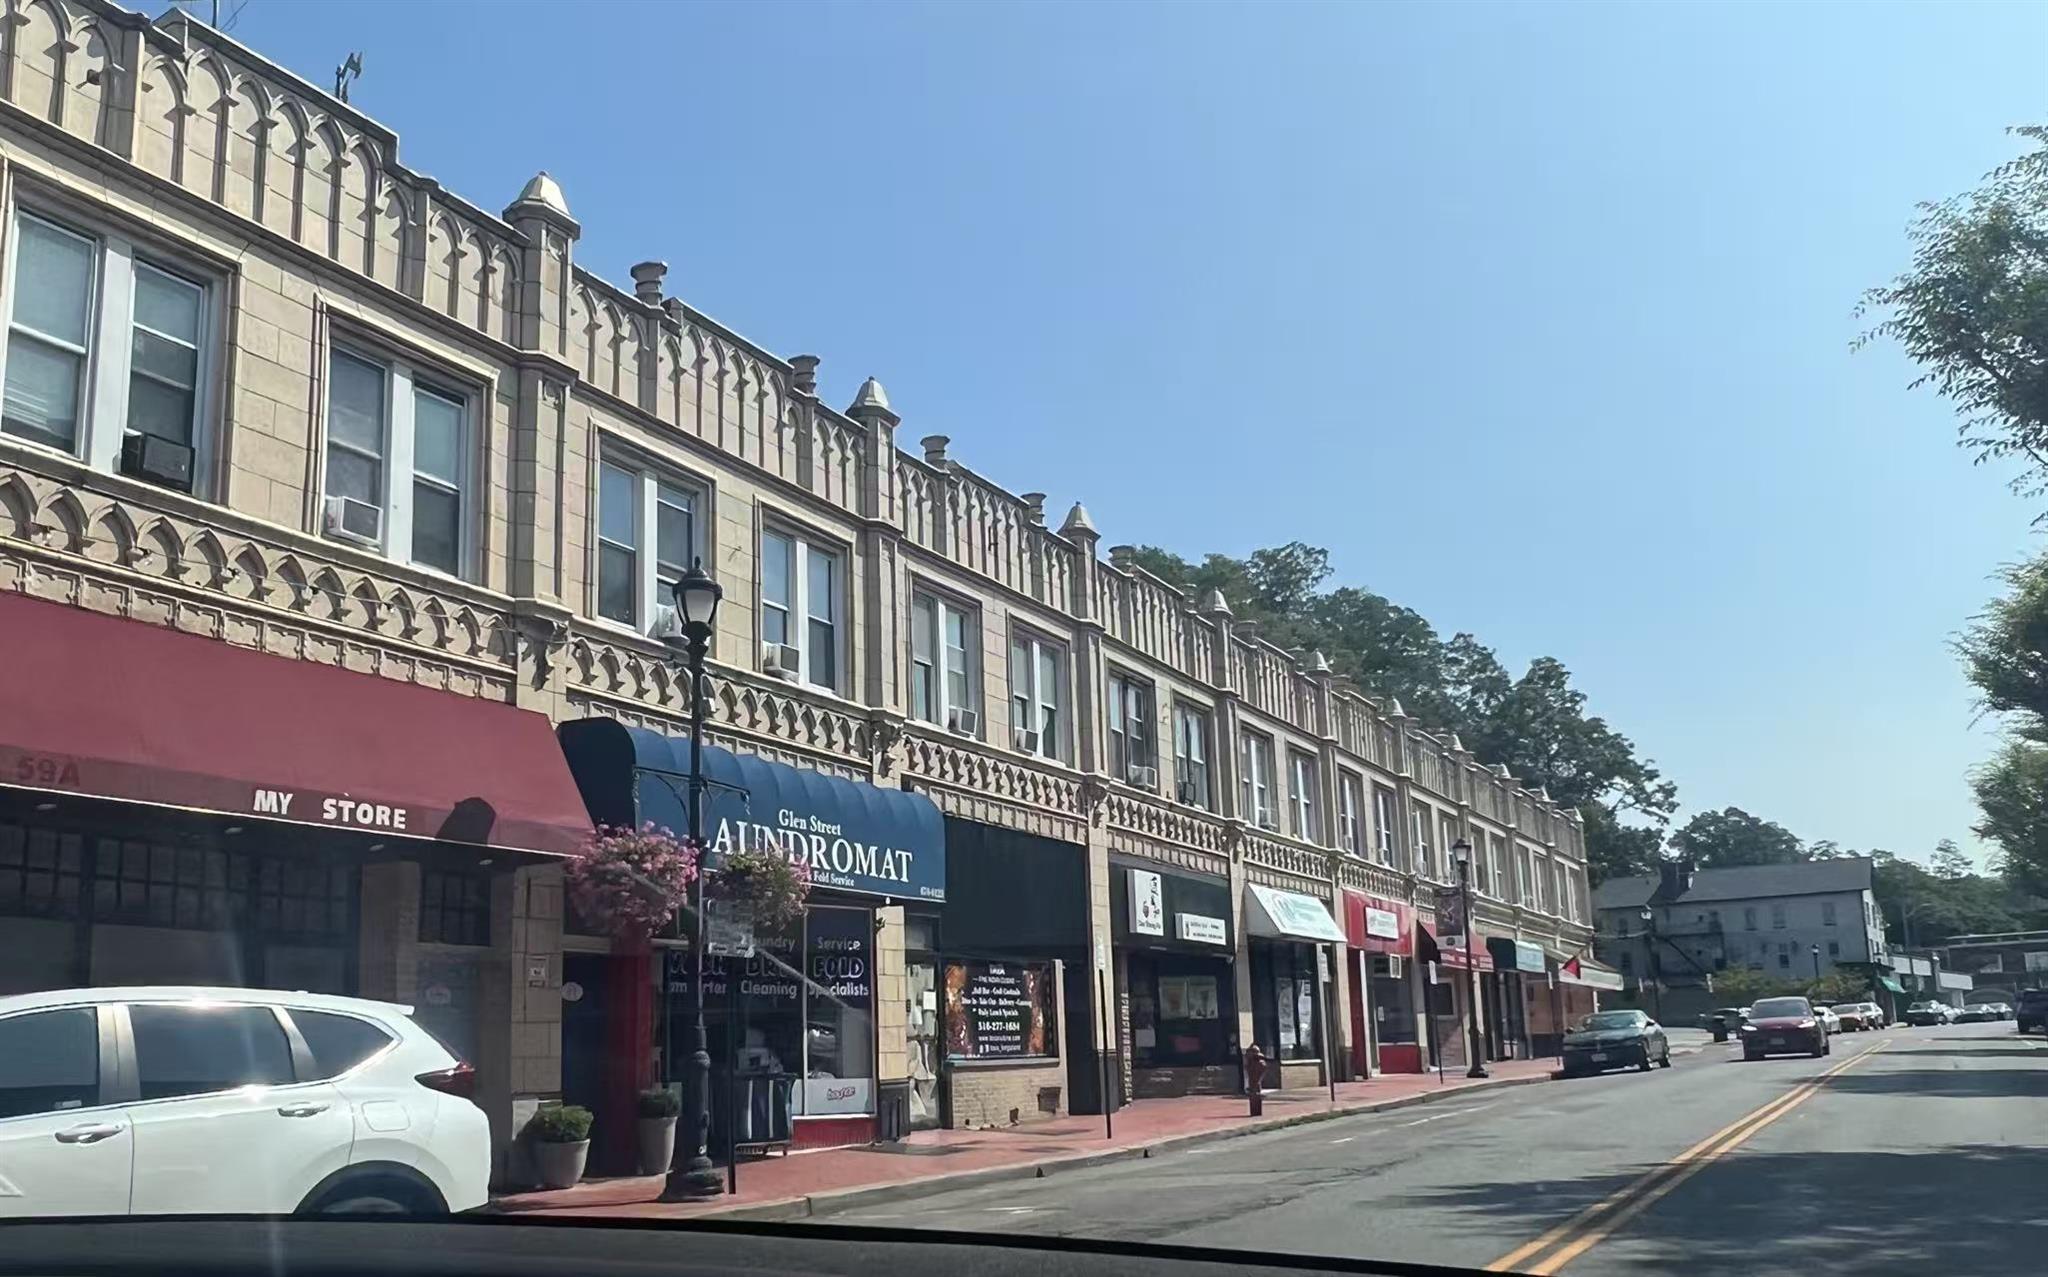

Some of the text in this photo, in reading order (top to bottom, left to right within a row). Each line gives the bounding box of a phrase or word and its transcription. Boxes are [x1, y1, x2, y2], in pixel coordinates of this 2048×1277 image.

[18, 755, 81, 787] 59A
[253, 789, 407, 830] MY STORE
[778, 808, 842, 836] Glen Street
[704, 817, 913, 883] AUNDROMAT
[830, 873, 855, 887] Service
[817, 936, 861, 951] Service
[813, 956, 865, 979] FOLD
[740, 980, 798, 1000] Cleaning
[808, 981, 870, 999] Spcialists
